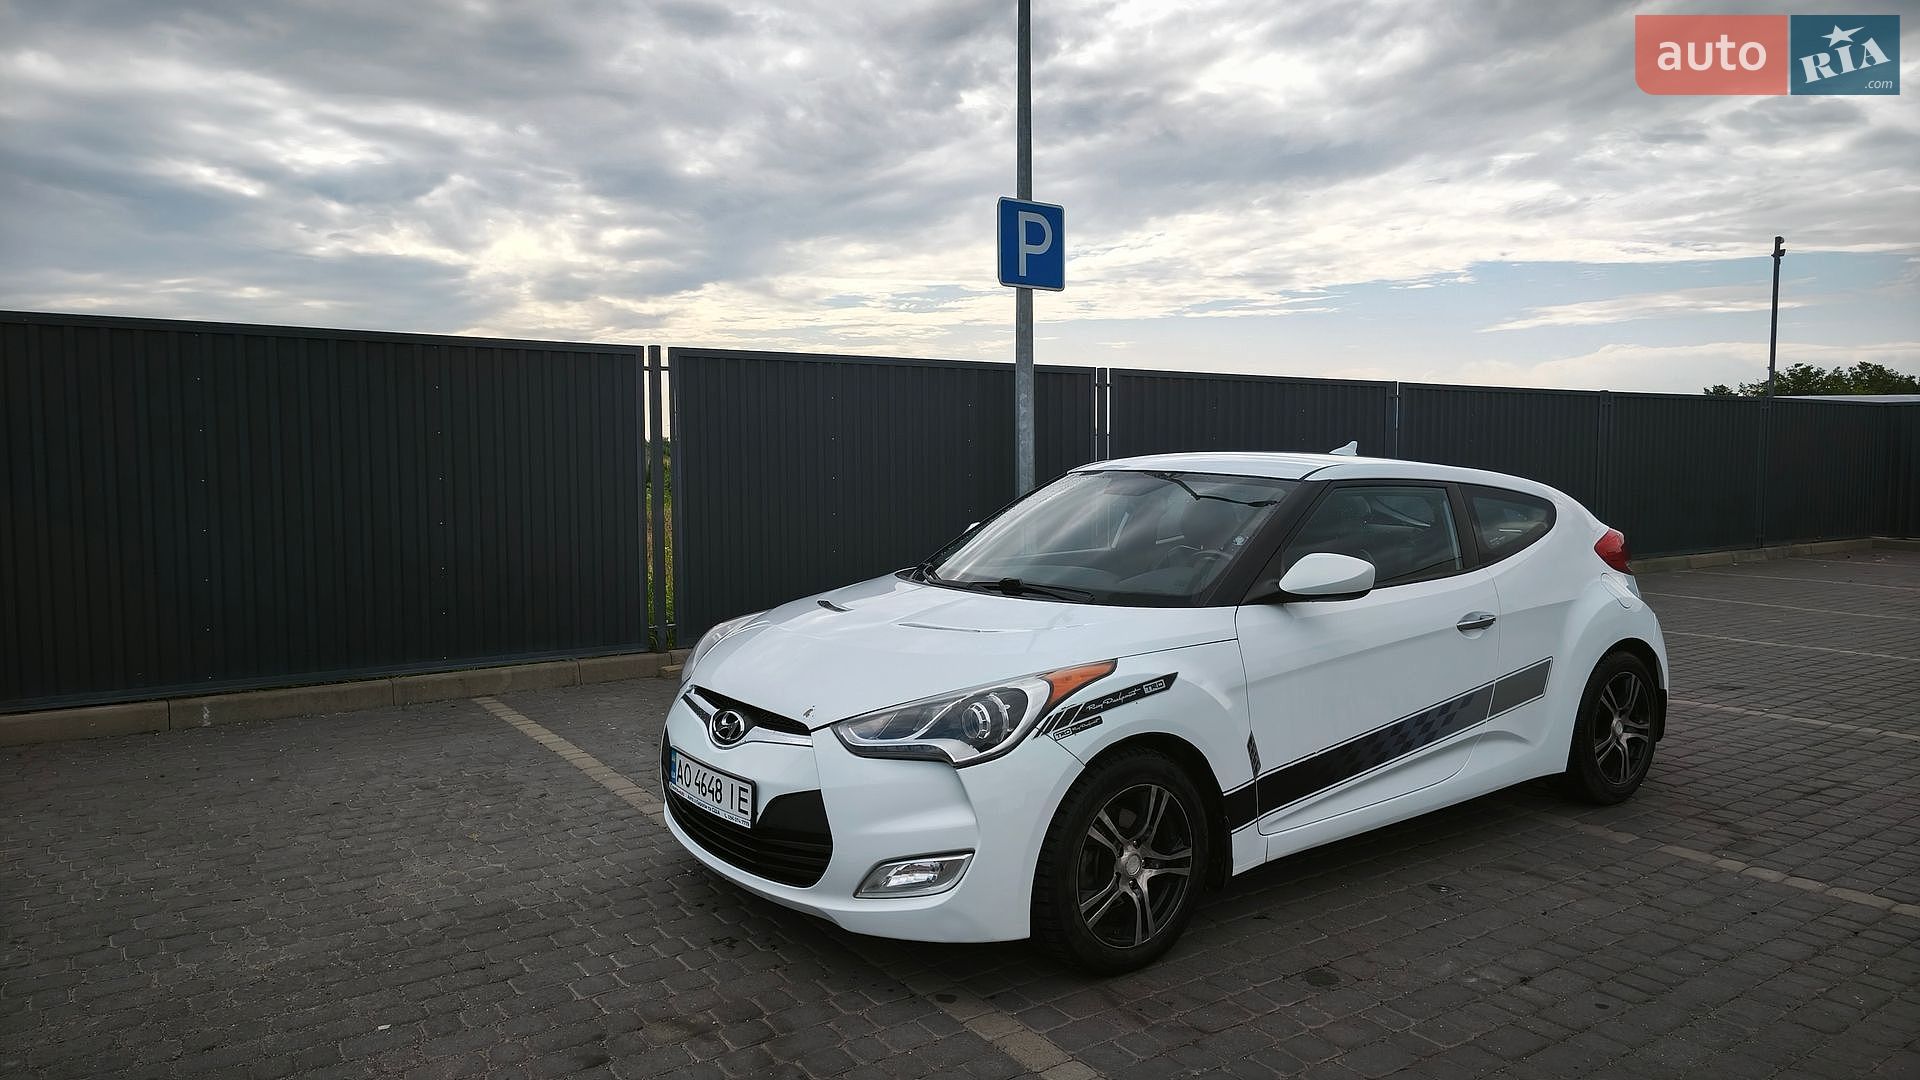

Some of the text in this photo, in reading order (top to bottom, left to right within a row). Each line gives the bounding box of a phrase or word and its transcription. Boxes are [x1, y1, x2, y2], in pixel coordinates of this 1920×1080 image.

[1018, 210, 1053, 277] P
[676, 759, 692, 788] AO
[694, 769, 723, 804] 4648
[730, 783, 749, 816] IE
